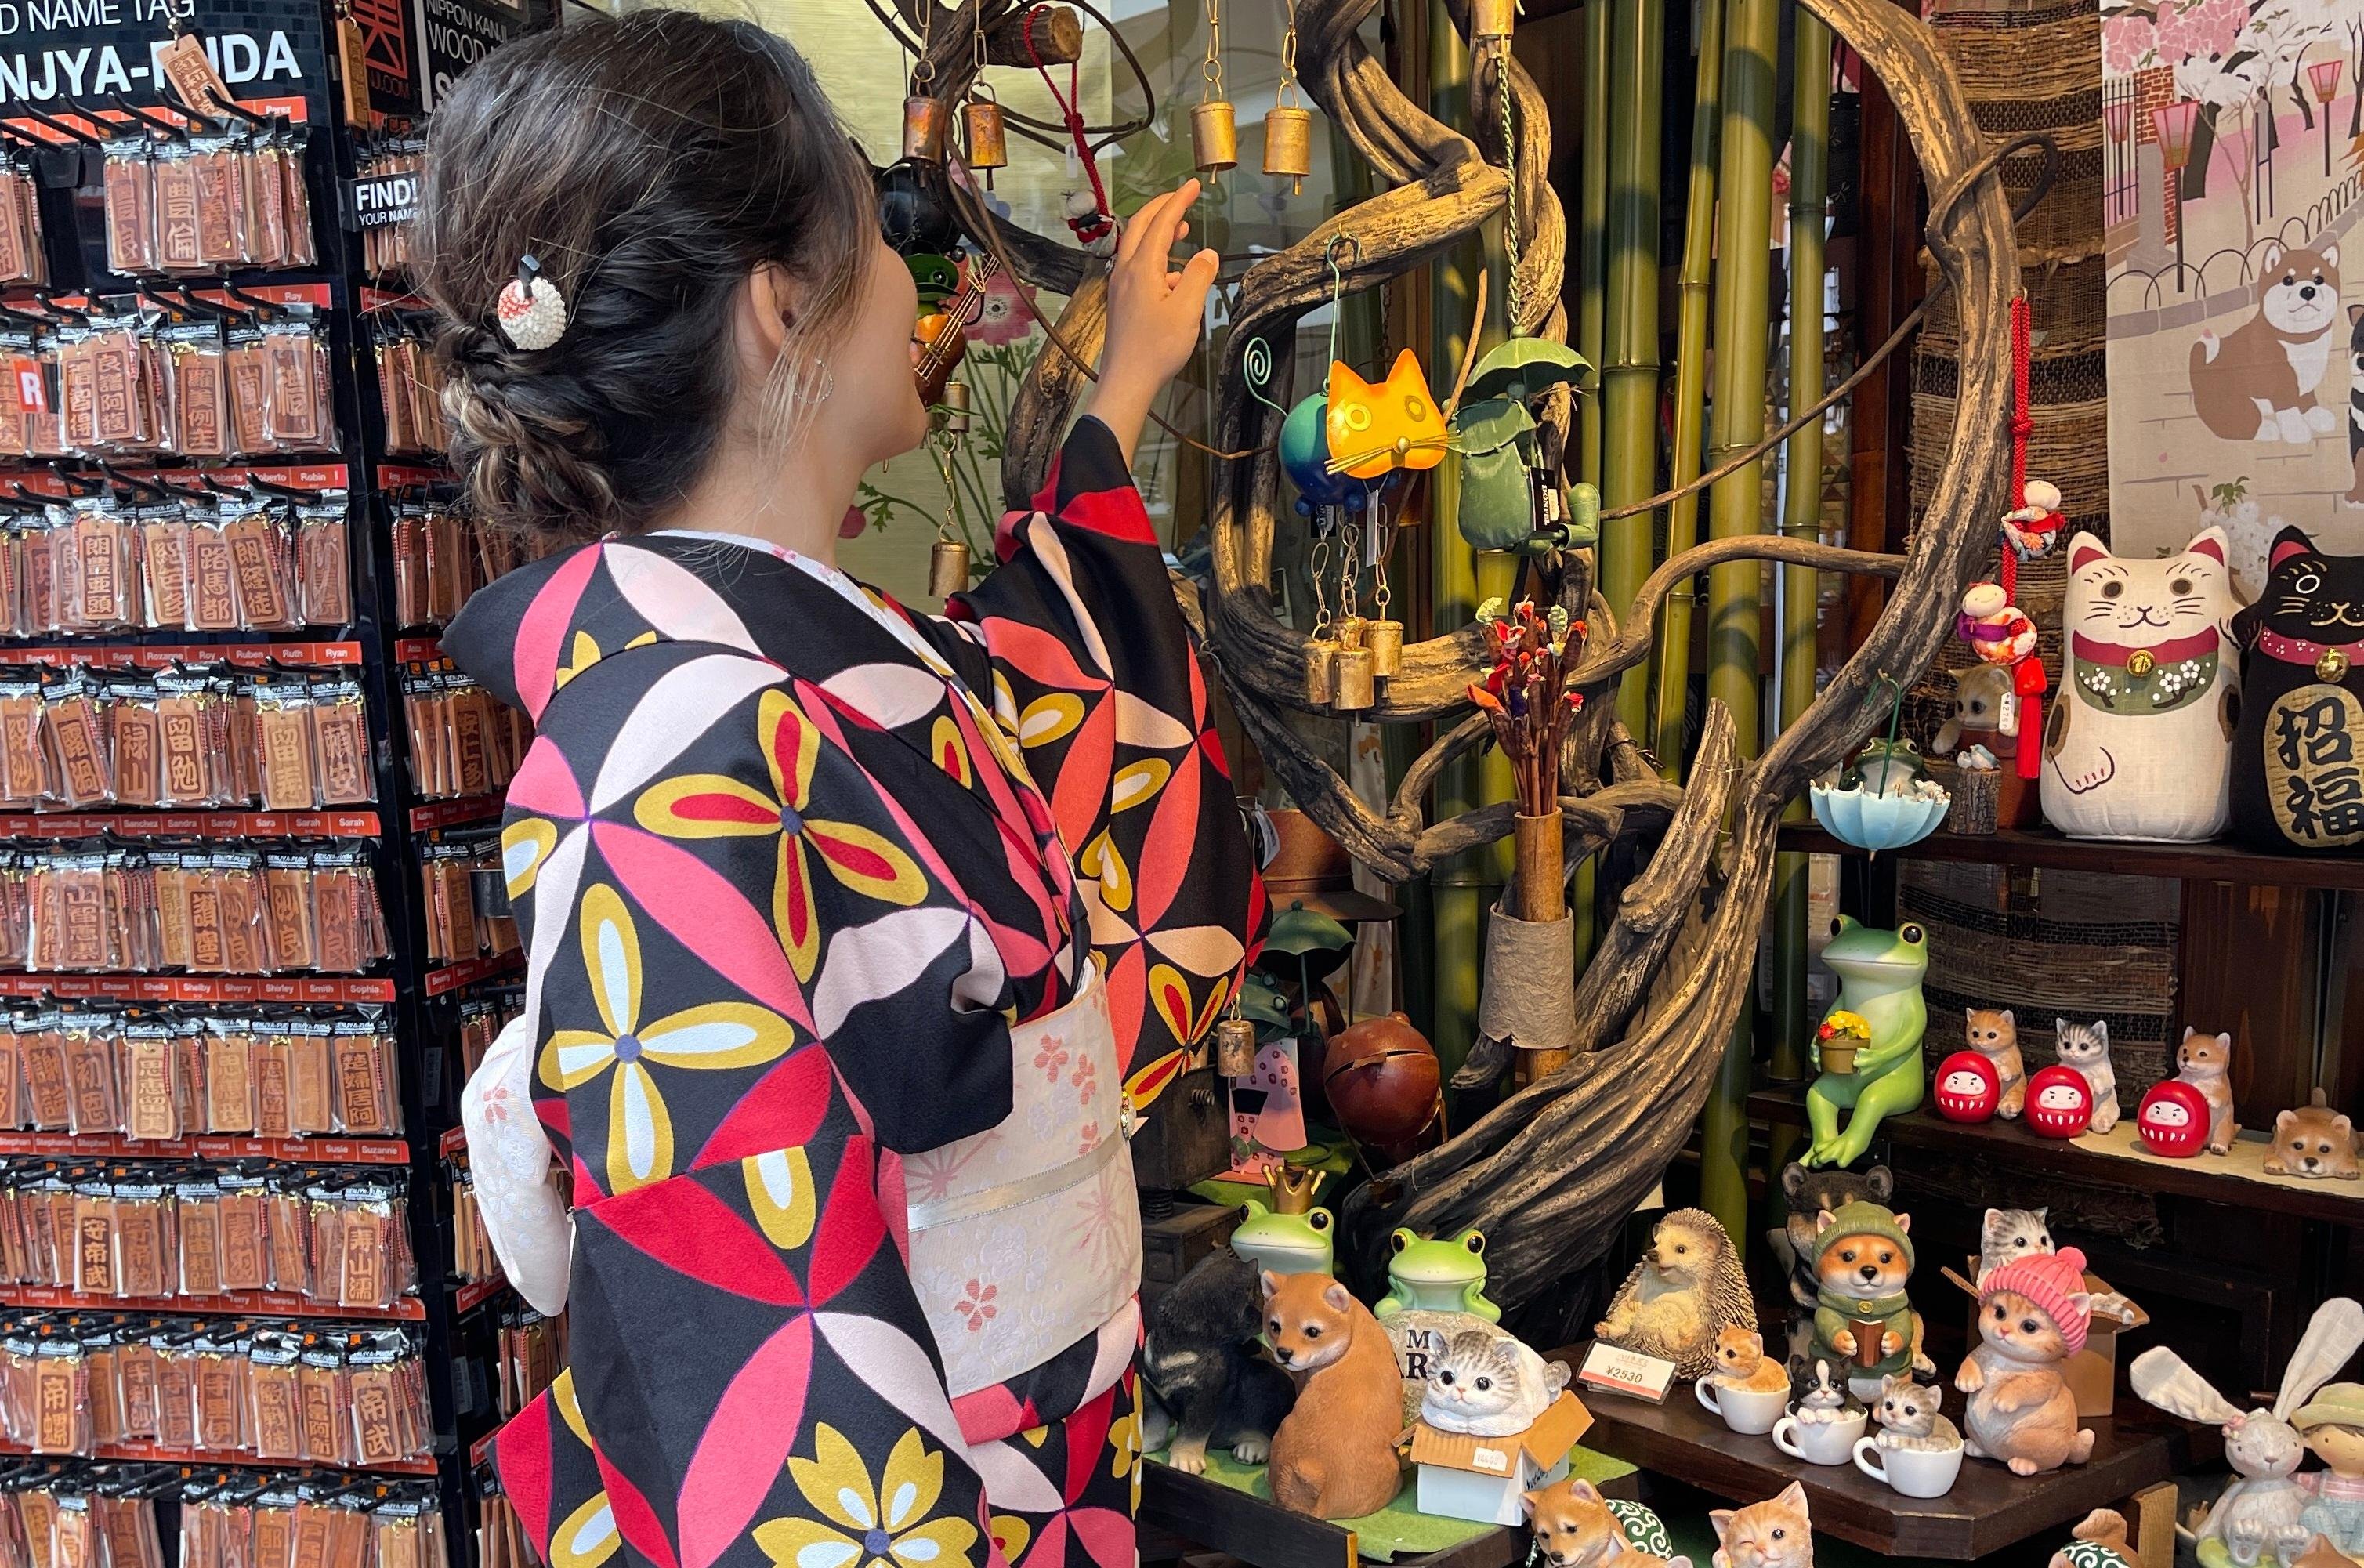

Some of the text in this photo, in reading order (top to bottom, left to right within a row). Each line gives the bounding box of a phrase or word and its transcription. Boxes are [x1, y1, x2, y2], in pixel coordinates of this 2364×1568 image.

[28, 0, 121, 33] NAME
[426, 0, 472, 30] NIPPON
[427, 20, 486, 64] WOOD
[355, 177, 418, 212] FIND!
[358, 211, 387, 226] YOUR
[284, 292, 302, 302] Ray
[20, 372, 43, 405] R
[255, 473, 287, 482] oberto
[300, 473, 326, 482] Robin
[325, 649, 348, 659] Ryan
[2276, 697, 2364, 839] 招福
[256, 818, 276, 827] Sara
[296, 817, 320, 827] Sarah
[339, 817, 364, 827] Sarah
[310, 984, 334, 993] Smith
[350, 984, 379, 994] Sophia
[246, 1142, 262, 1151] Sue
[282, 1143, 309, 1153] Susan
[325, 1144, 349, 1153] Susie
[361, 1145, 398, 1155] Suzanne
[1606, 1365, 1643, 1383] ¥2530
